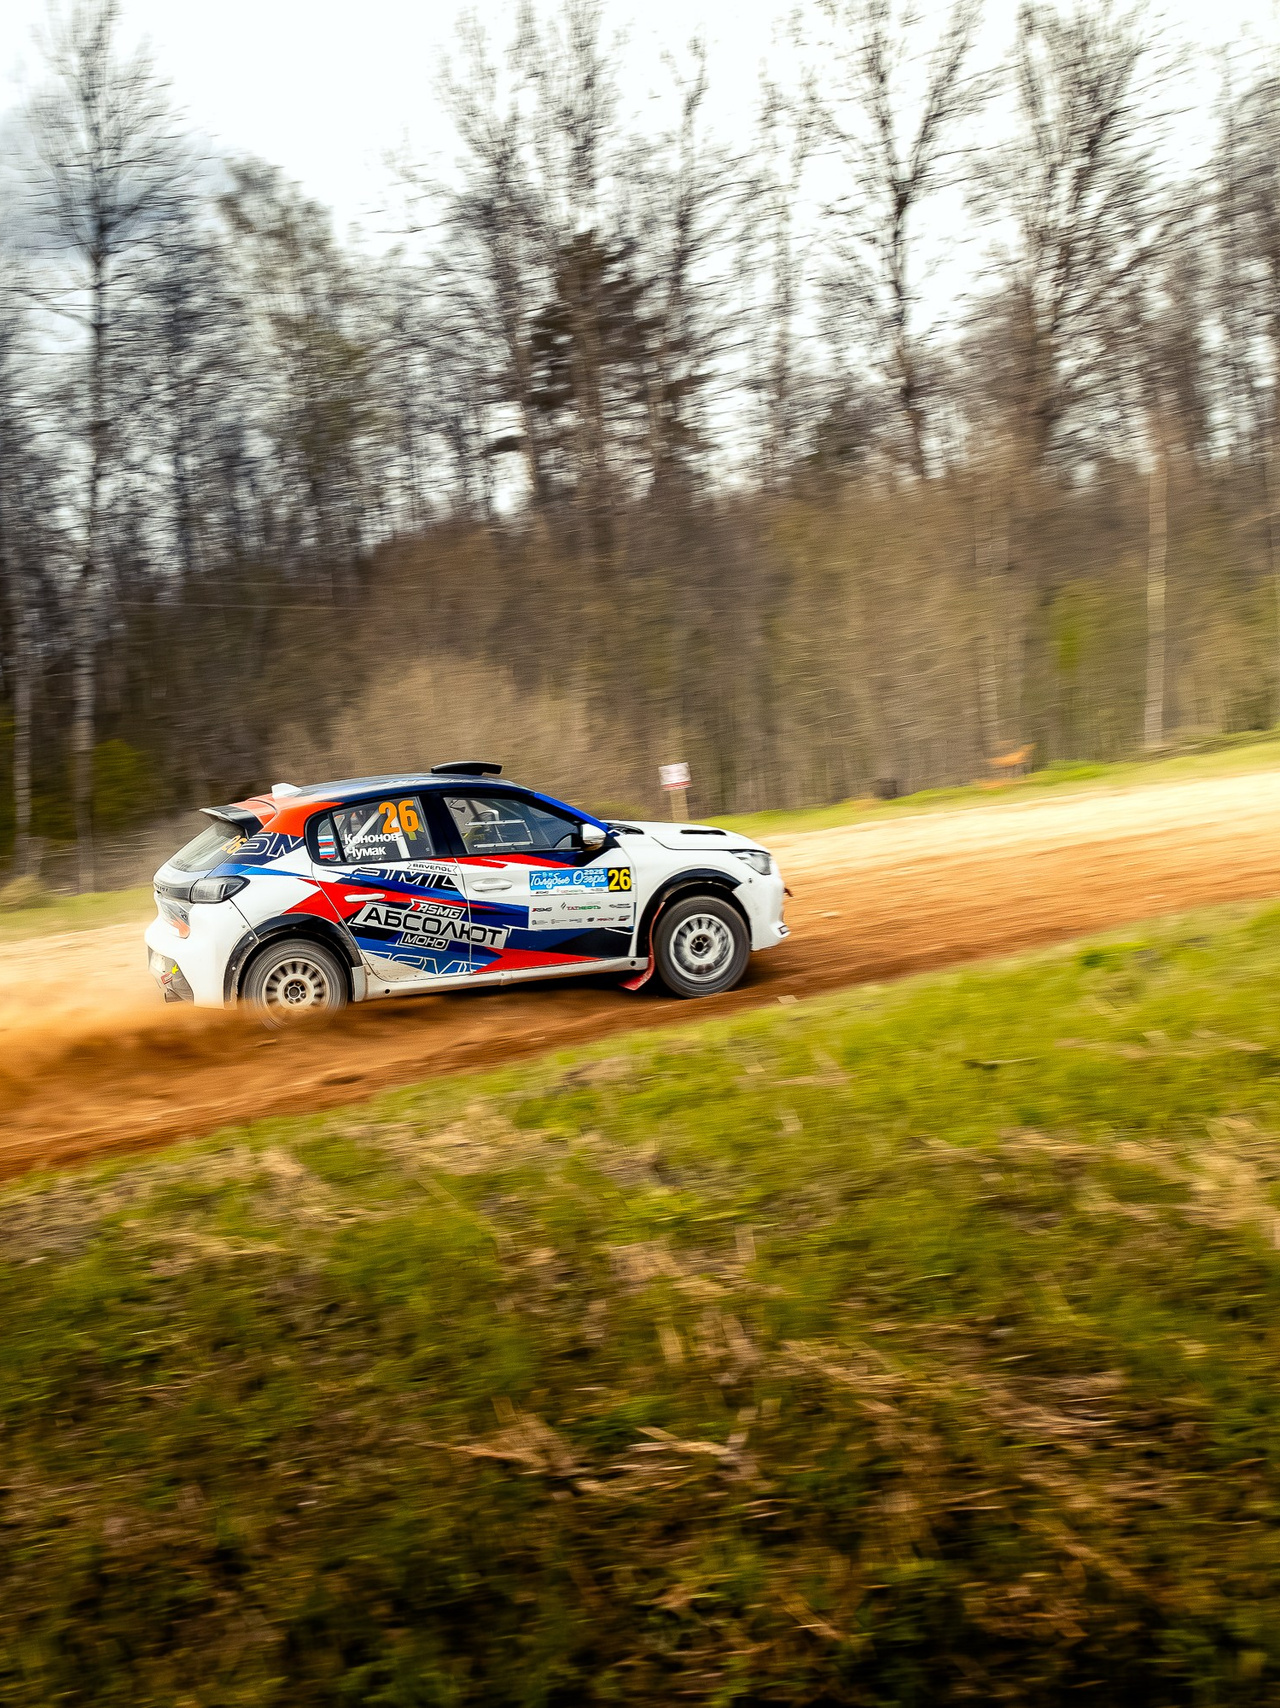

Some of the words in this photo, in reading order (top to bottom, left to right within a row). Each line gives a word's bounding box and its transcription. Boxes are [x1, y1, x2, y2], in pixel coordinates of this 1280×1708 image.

[378, 800, 419, 834] 26
[222, 835, 248, 854] 26
[344, 833, 399, 845] Кононов
[345, 846, 386, 859] Чумак
[412, 863, 453, 873] RAVENOL
[608, 869, 631, 890] 26
[412, 902, 462, 918] ASMG
[363, 906, 504, 946] АБСОЛЮТ
